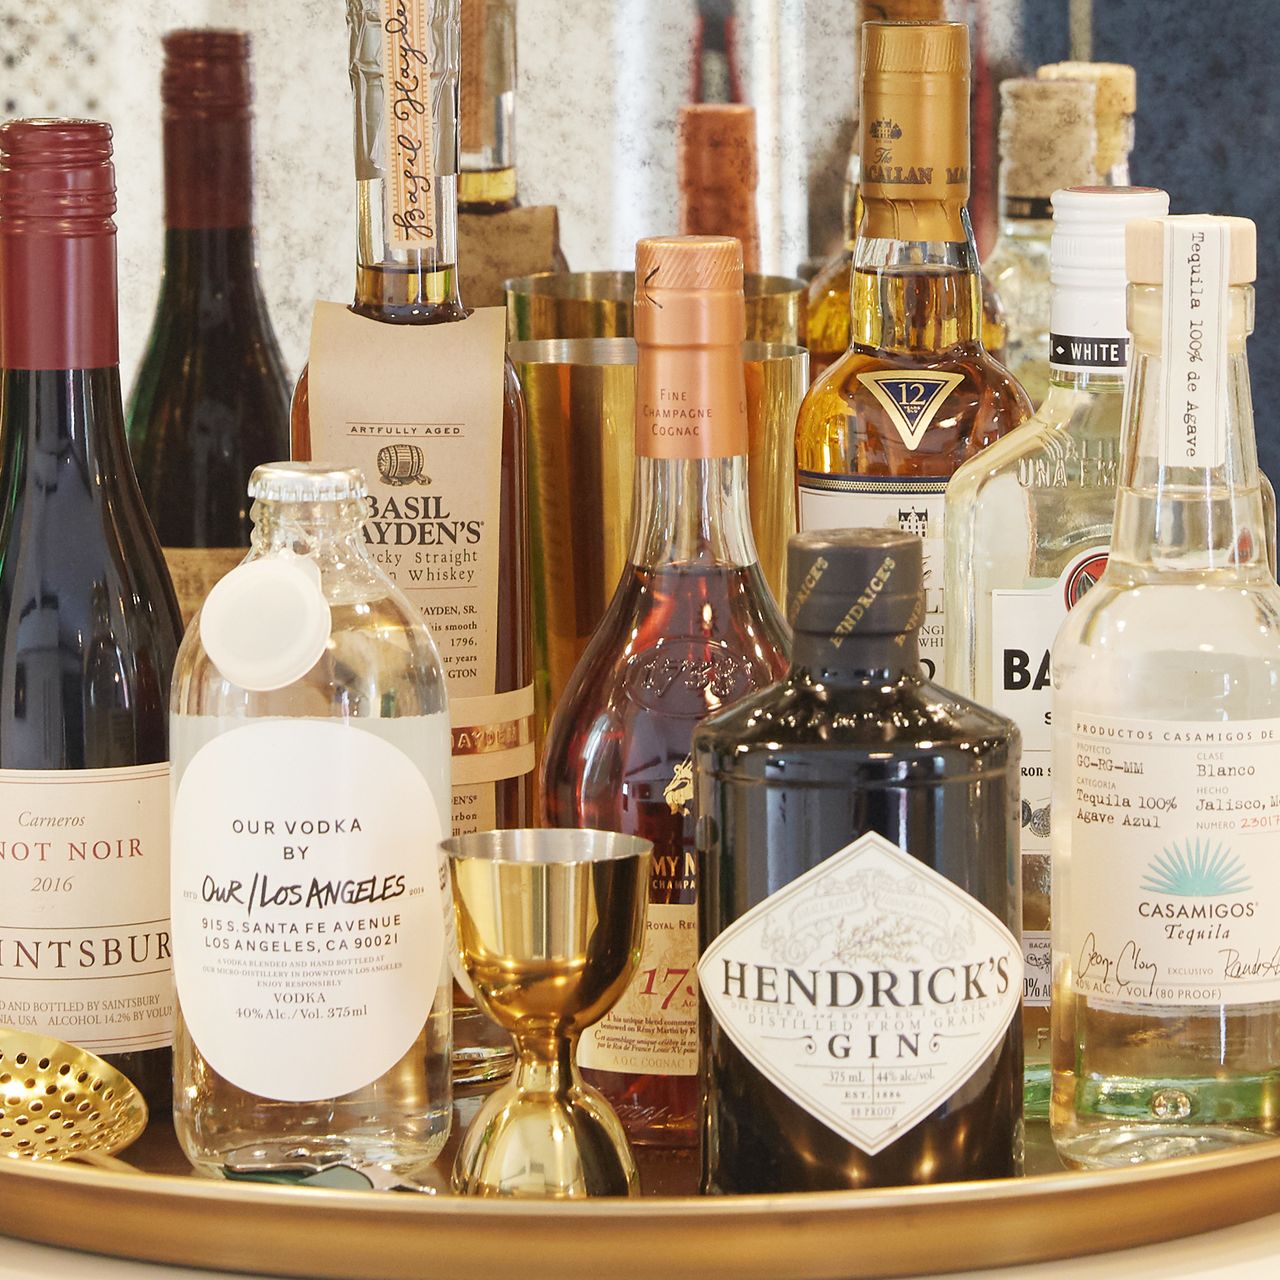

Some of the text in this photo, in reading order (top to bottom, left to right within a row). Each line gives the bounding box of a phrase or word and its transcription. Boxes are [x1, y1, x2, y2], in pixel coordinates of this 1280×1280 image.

[873, 147, 893, 164] The
[393, 134, 434, 241] Basil
[1071, 342, 1119, 362] WHITE
[1183, 232, 1205, 458] Tequila 100% de Agave
[898, 383, 926, 405] 12
[350, 426, 417, 434] ARTFULLY
[415, 549, 478, 567] Straight
[409, 568, 475, 583] Whiskey
[463, 605, 478, 615] SR.
[445, 622, 478, 631] smooth
[456, 655, 478, 665] years
[1077, 723, 1154, 740] PRODUCTOS
[1163, 731, 1252, 742] CASAMIGOS
[1261, 730, 1274, 740] DE
[1077, 743, 1111, 755] PROYECTO
[1197, 752, 1224, 761] CLASE
[1077, 755, 1144, 775] GC-RG-MM
[1197, 764, 1256, 777] Blanco
[1197, 786, 1229, 795] HECHO
[1077, 788, 1178, 813] Tequila 100%
[1196, 798, 1266, 812] Jalisco,
[18, 811, 86, 827] Carneros
[232, 818, 363, 835] OUR VODKA
[1077, 809, 1161, 829] Agave Azul
[1240, 814, 1280, 829] 23017
[68, 838, 144, 862] NOIR
[283, 846, 310, 860] BY
[31, 876, 76, 893] 2016
[1138, 902, 1255, 919] CASAMIGOS
[202, 918, 223, 931] 915
[242, 922, 299, 935] SANTA
[305, 922, 327, 934] FE
[333, 914, 402, 933] AVENUE
[1165, 924, 1231, 945] Tequila
[205, 934, 399, 953] LOS ANGELES, CA 90021
[302, 969, 354, 978] DOWNTOWN
[1167, 967, 1214, 975] EXCLUSIVO
[257, 980, 343, 988] ENJOY RESPONSIBLY
[721, 955, 1010, 1009] HENDRICK'S
[274, 993, 327, 1004] VODKA
[1155, 987, 1222, 1001] (80 PROOF)
[8, 1001, 31, 1012] AND
[34, 1001, 84, 1013] BOTTLED
[87, 1000, 100, 1011] BY
[102, 993, 160, 1010] SAINTSBURY
[18, 1010, 146, 1026] USA ALCOHOL 14.2% BY
[235, 1008, 264, 1019] 40%
[748, 1013, 986, 1032] DISTILLED FROM GRAIN
[828, 1033, 921, 1059] GIN
[829, 1070, 898, 1082] 375 44%
